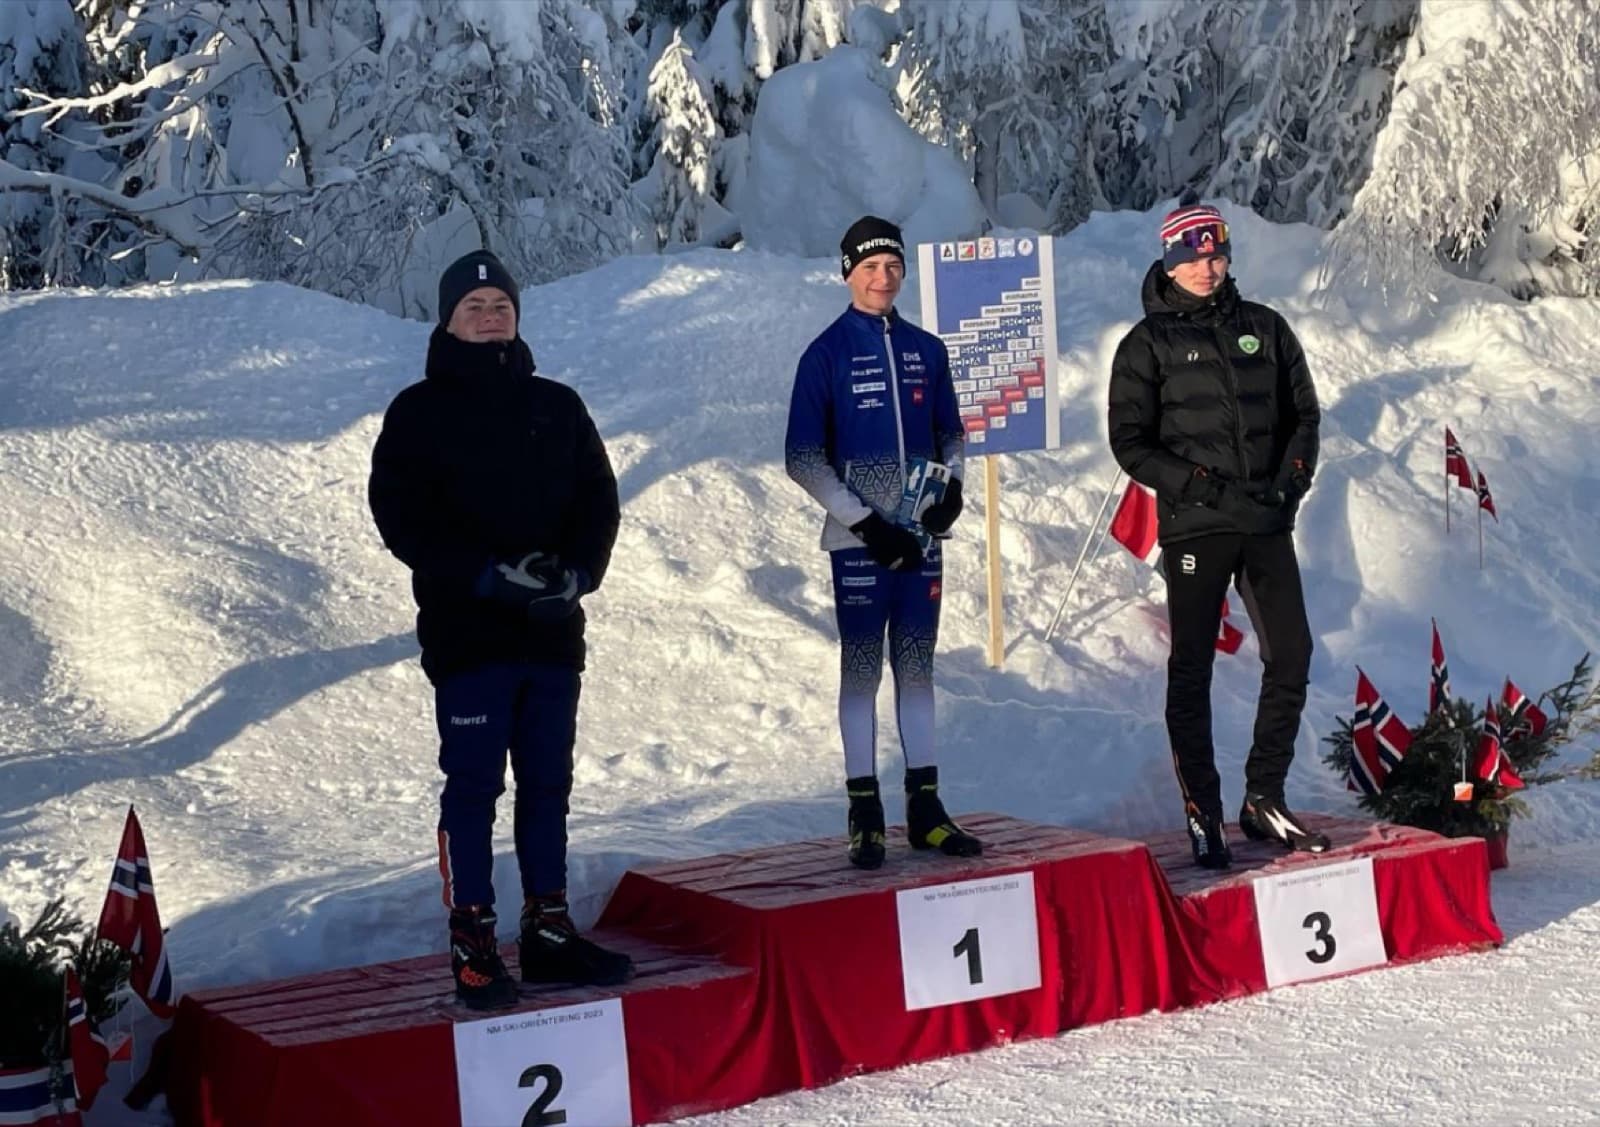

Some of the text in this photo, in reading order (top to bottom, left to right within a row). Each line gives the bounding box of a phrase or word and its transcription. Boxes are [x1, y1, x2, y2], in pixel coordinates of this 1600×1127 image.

[953, 927, 983, 985] 1
[1302, 911, 1337, 964] 3
[487, 1024, 502, 1035] NM
[583, 1008, 604, 1020] 2023
[517, 1063, 567, 1127] 2
